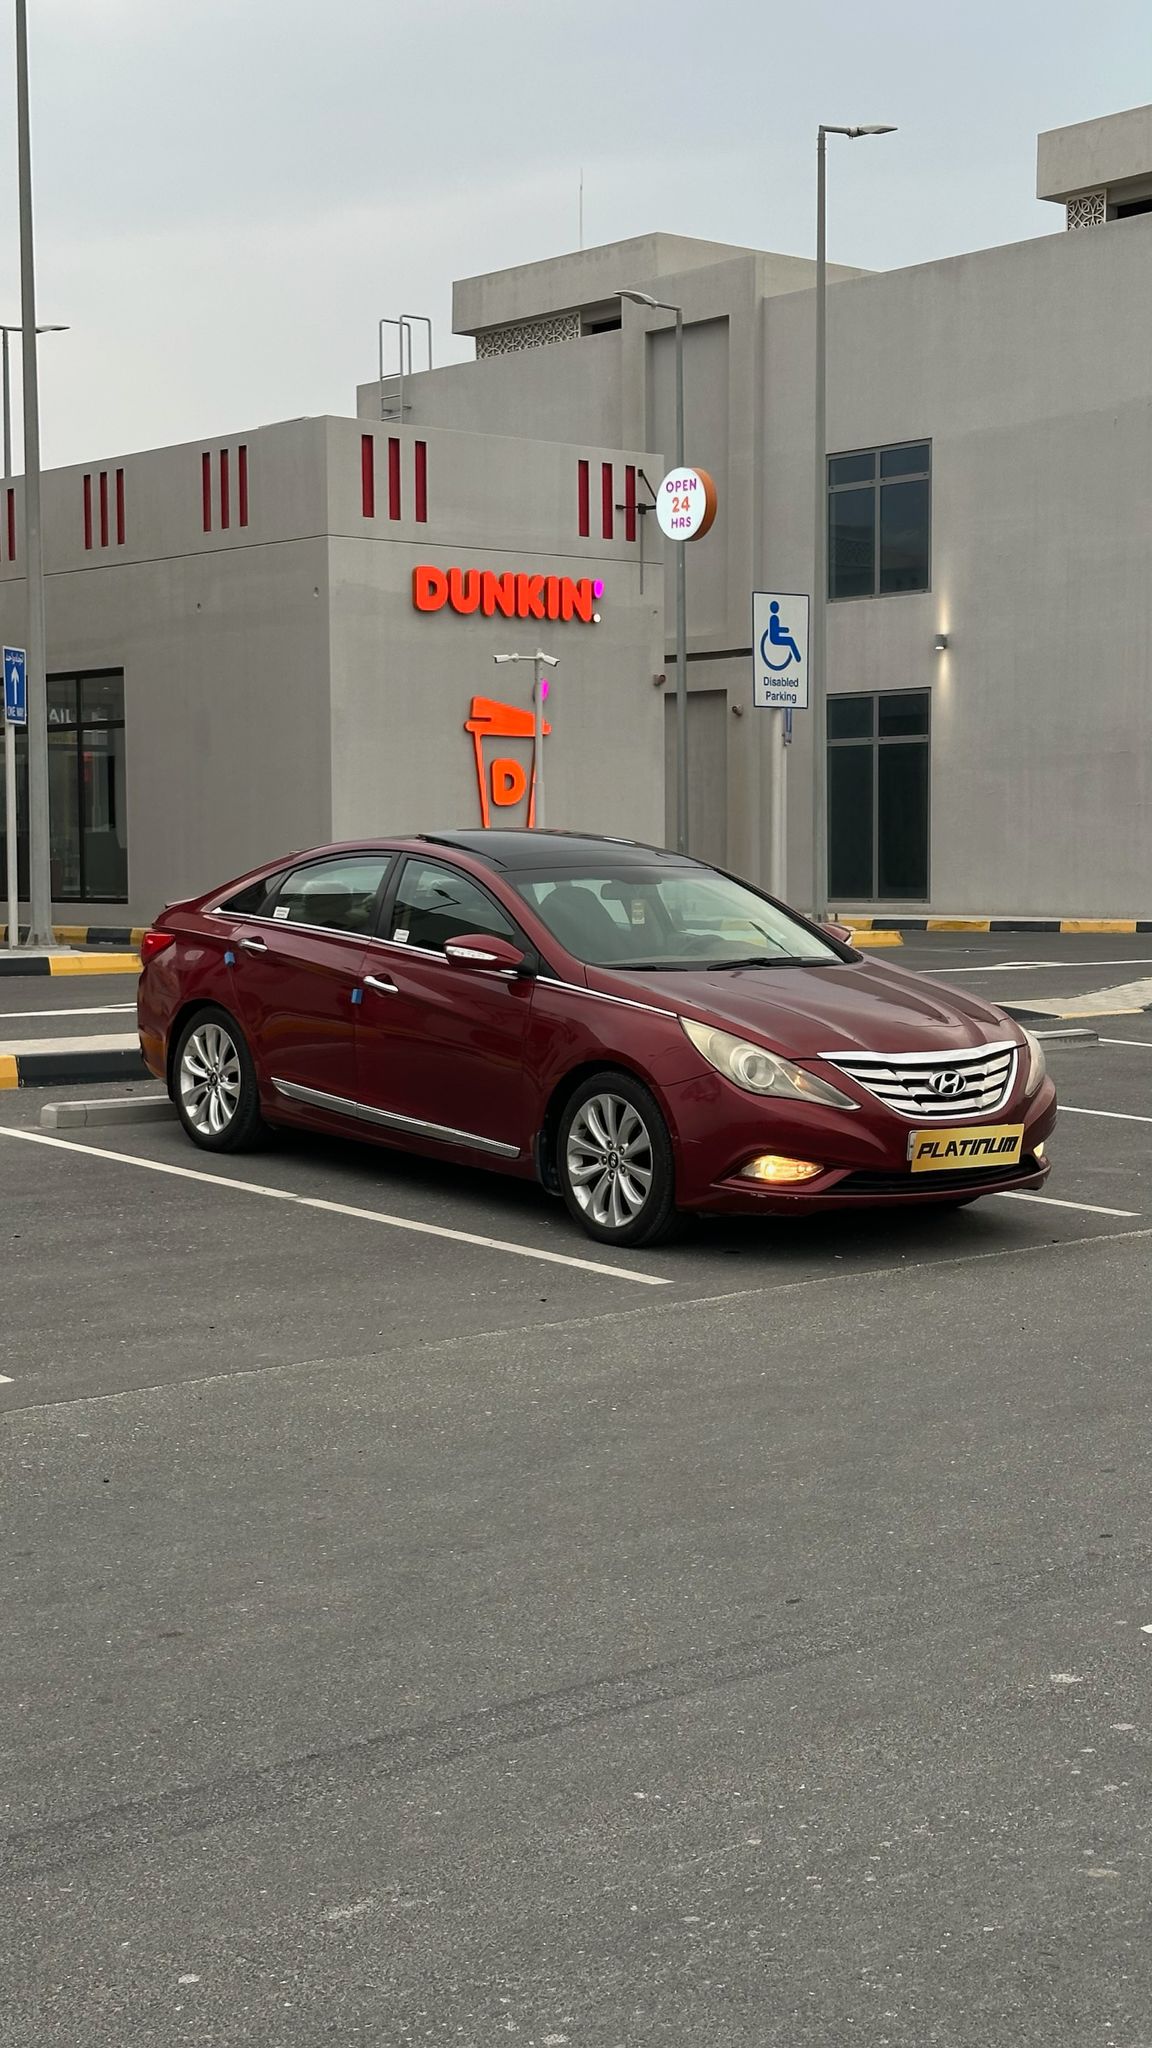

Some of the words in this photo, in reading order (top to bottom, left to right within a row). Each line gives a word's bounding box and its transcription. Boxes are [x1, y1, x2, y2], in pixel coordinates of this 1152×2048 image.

[665, 478, 697, 493] OPEN
[672, 496, 690, 513] 24
[671, 516, 691, 529] HRS
[763, 676, 799, 687] Disabled
[765, 691, 797, 704] Parking
[490, 758, 527, 807] D
[916, 1136, 1020, 1159] PLATINUM
